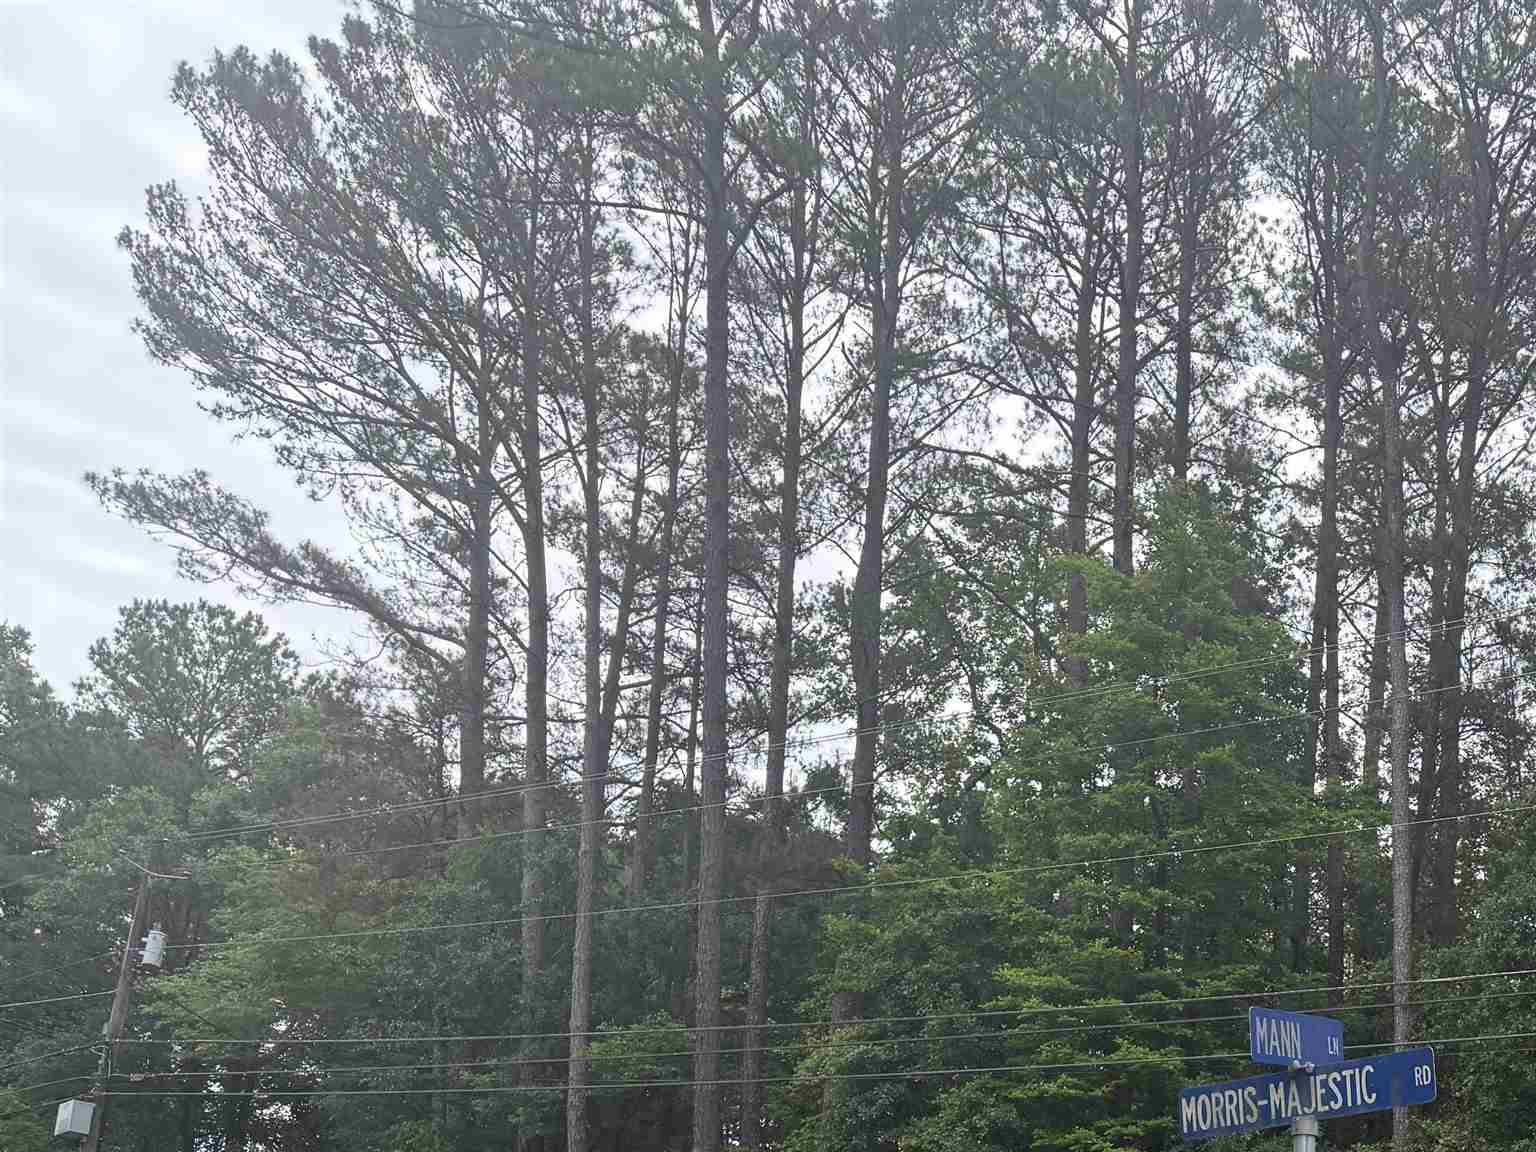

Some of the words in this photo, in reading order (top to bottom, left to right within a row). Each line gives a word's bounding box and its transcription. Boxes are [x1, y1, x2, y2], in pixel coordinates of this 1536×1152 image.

[1255, 1016, 1302, 1058] MANN
[1328, 1036, 1339, 1056] LN
[1181, 1064, 1377, 1134] MORRIS-MAJESTIC
[1414, 1064, 1432, 1087] RD
